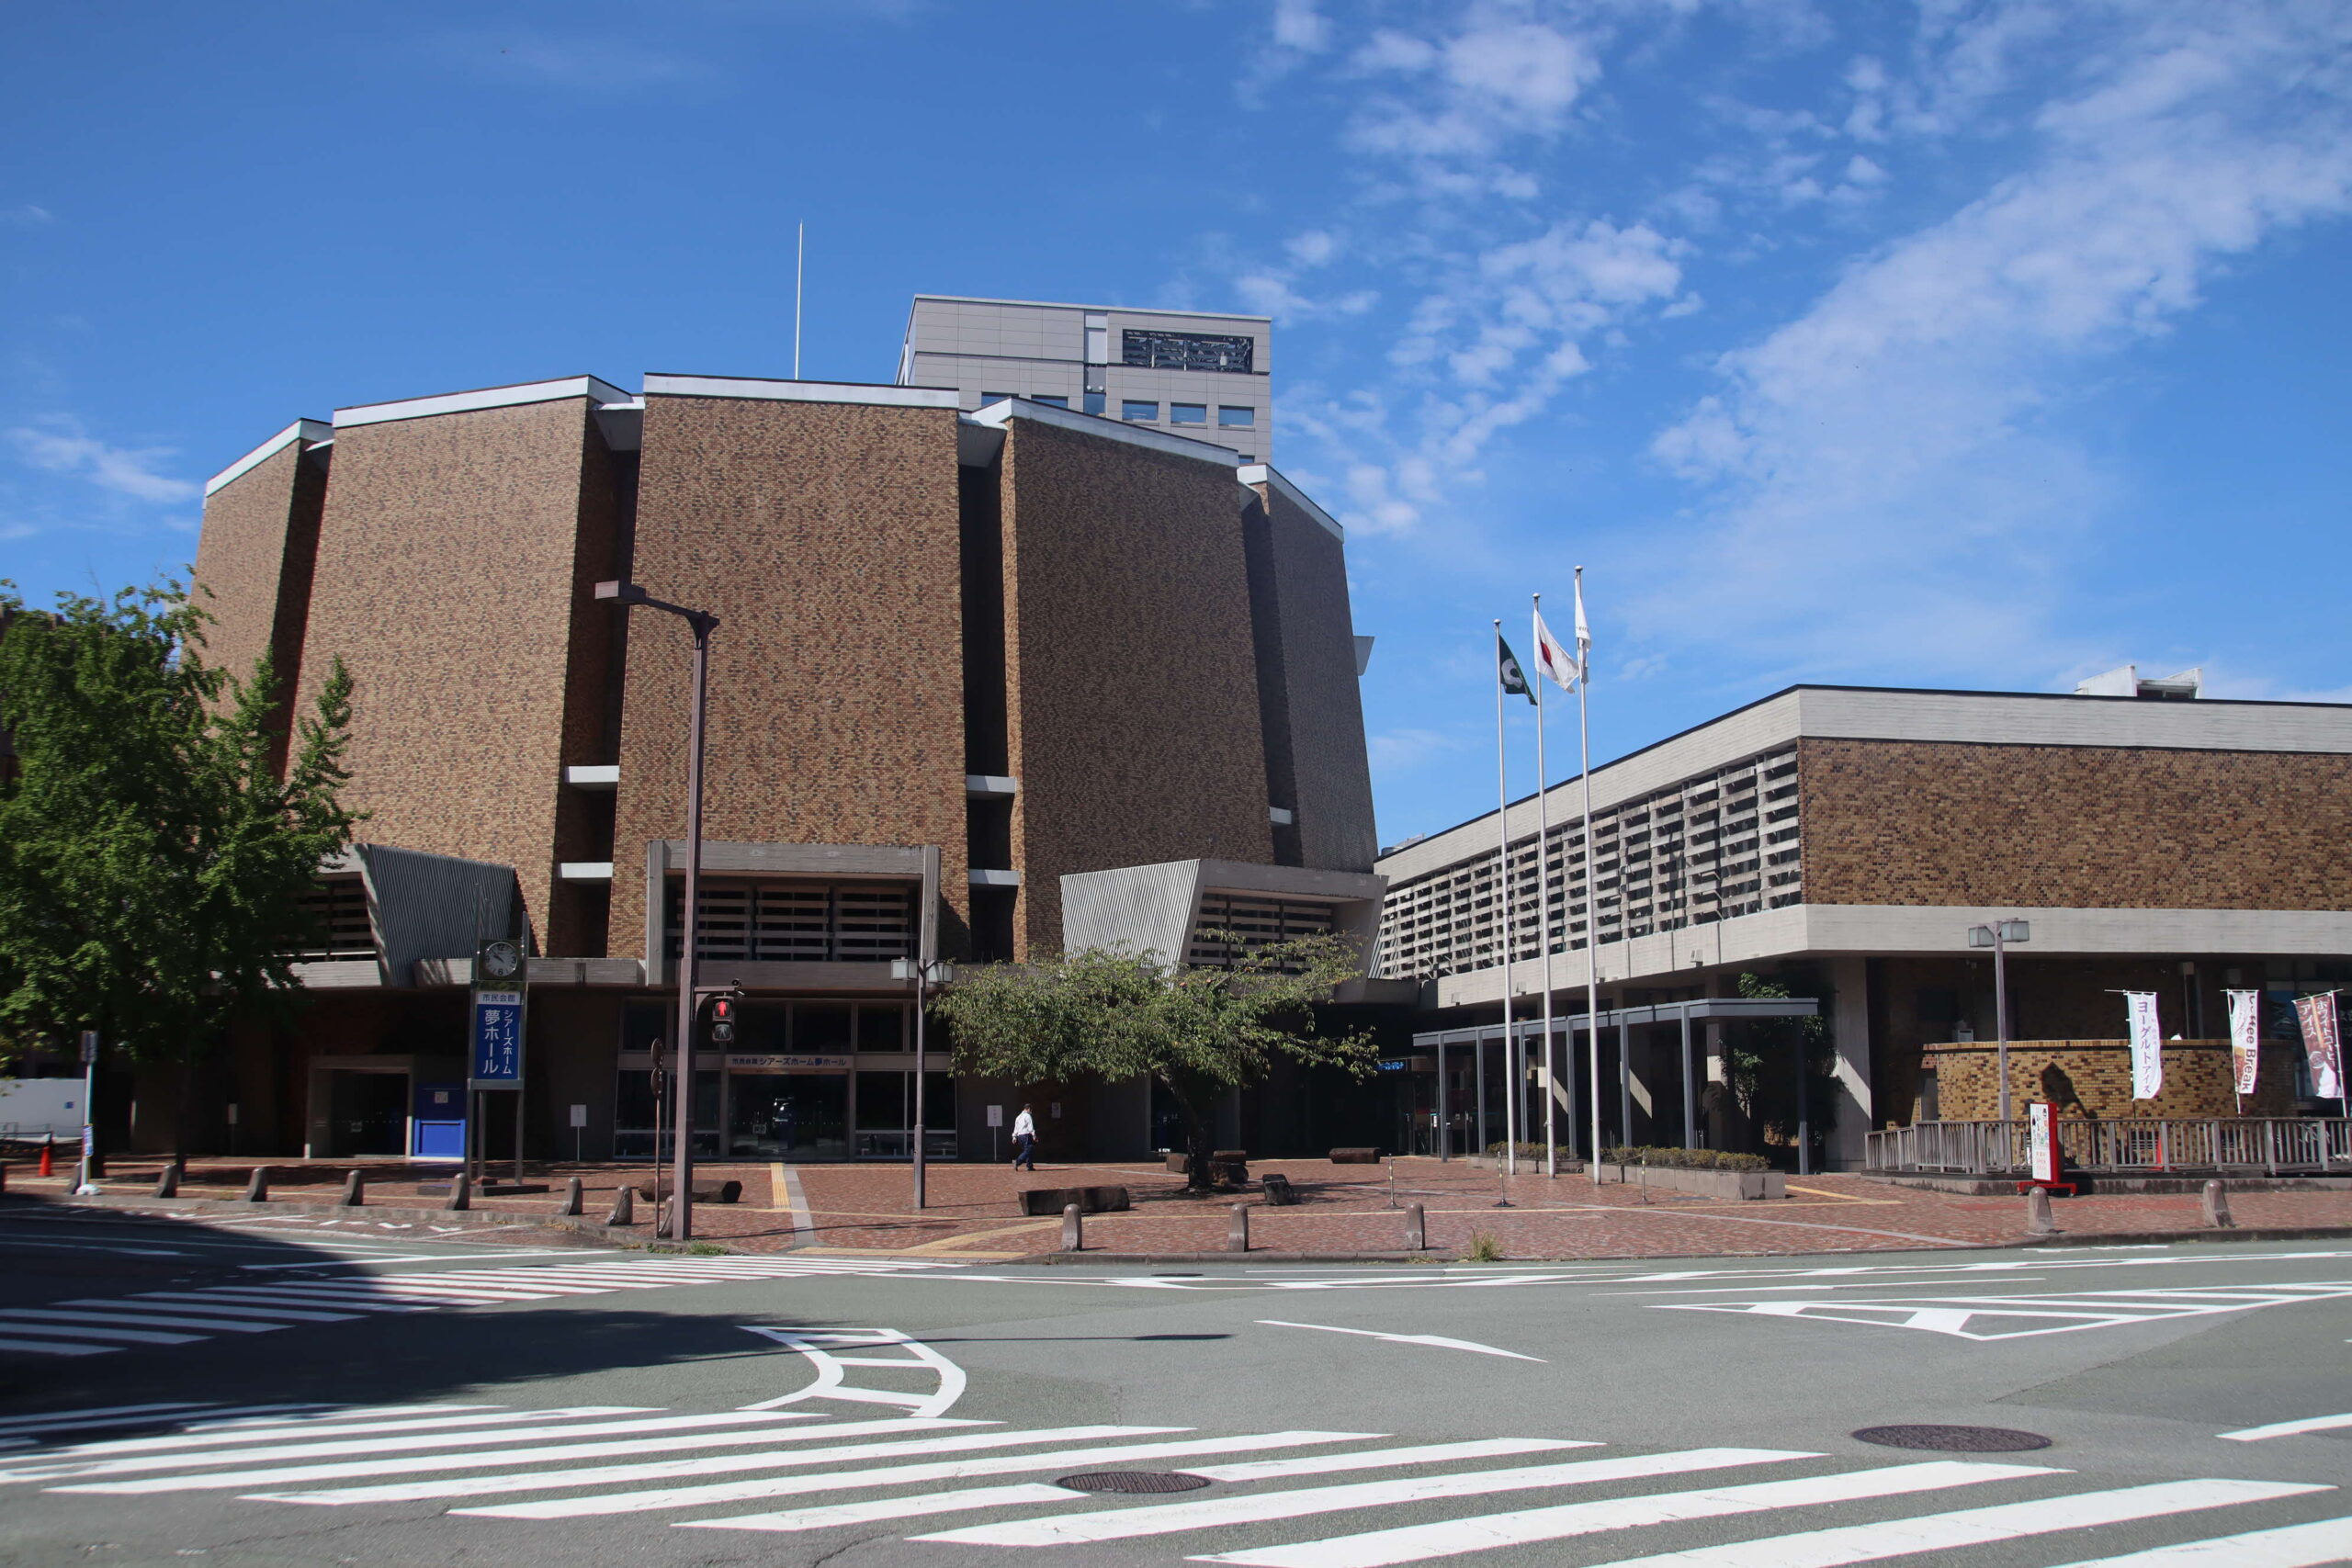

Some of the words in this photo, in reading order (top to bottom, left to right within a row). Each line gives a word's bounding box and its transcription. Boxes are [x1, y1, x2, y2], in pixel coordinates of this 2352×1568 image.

[482, 994, 515, 1002] 市民会館
[2300, 1004, 2316, 1038] アイス
[483, 1010, 501, 1074] 夢ホール
[503, 1010, 514, 1074] シアーズホーム
[2138, 1001, 2151, 1093] ヨーグルトアイス
[2316, 1000, 2335, 1066] ホワイトコーヒー
[2242, 1049, 2256, 1091] Break
